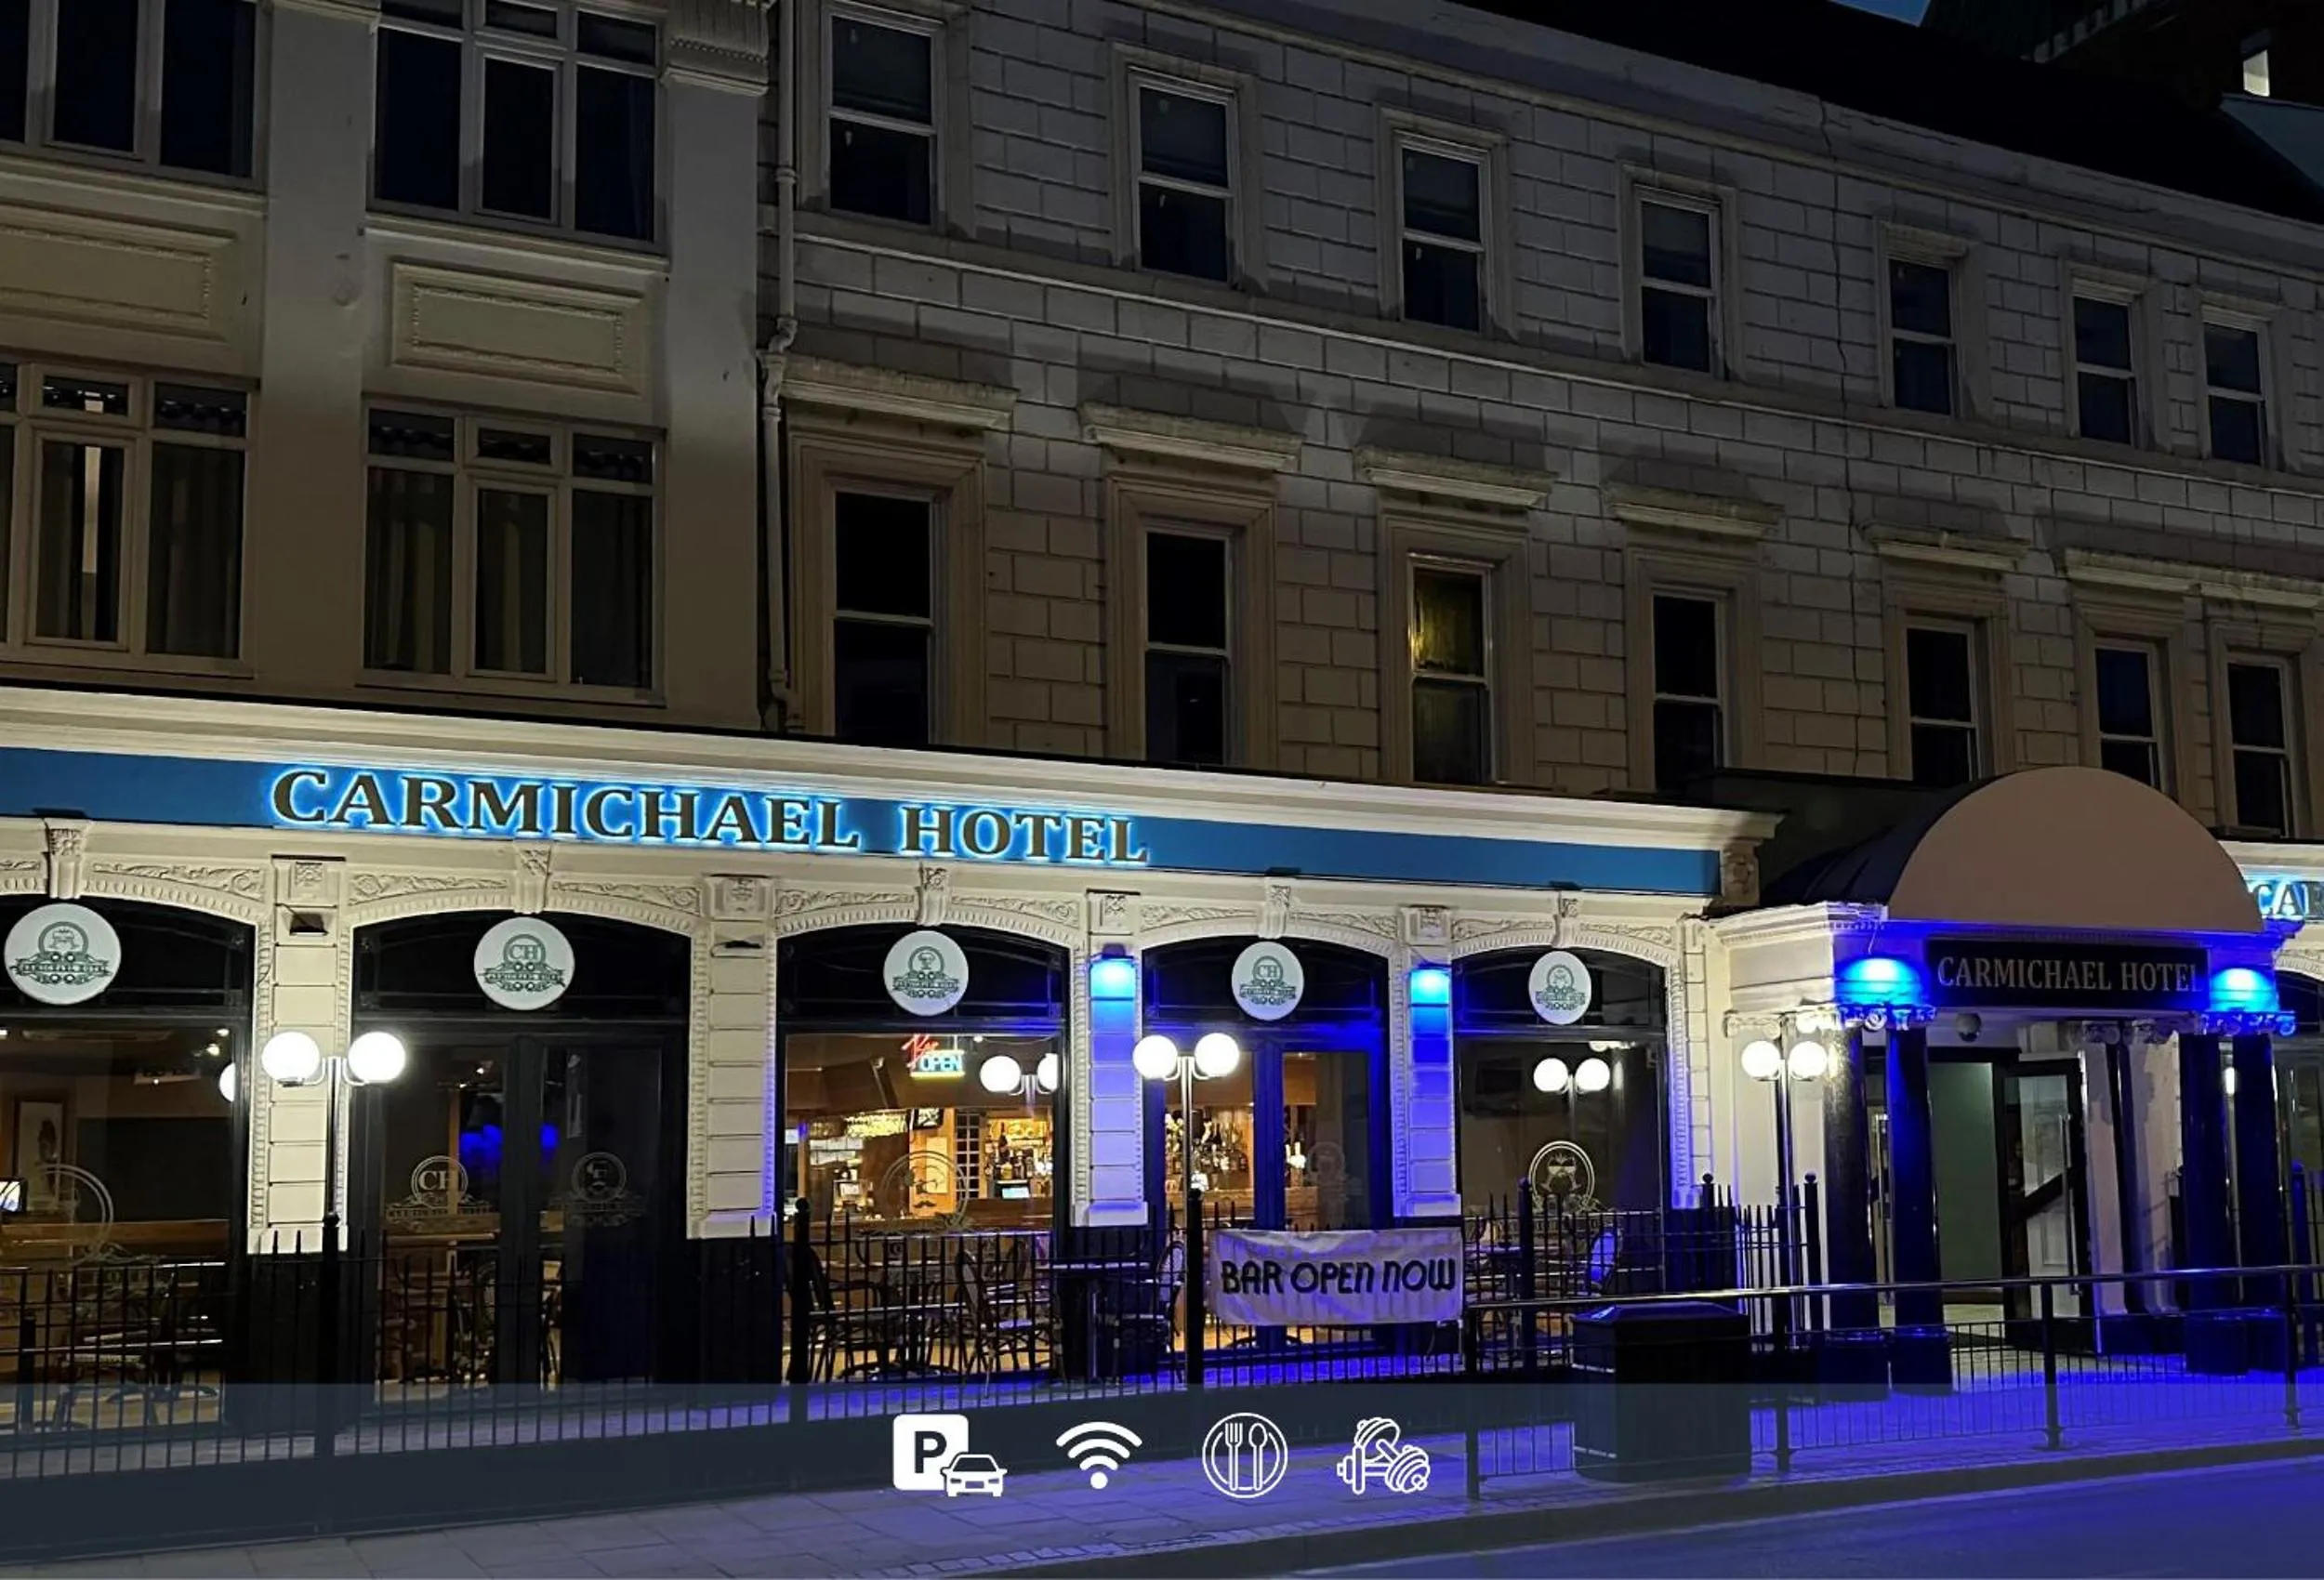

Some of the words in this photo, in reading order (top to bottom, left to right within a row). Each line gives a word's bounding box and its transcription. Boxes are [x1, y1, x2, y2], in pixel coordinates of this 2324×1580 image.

[272, 770, 860, 847] CARMICHAEL
[902, 806, 1148, 862] HOTEL
[1937, 956, 2112, 990] CARMICHAEL
[2119, 962, 2203, 993] HOTEL
[1221, 1260, 1284, 1295] BAR
[1289, 1261, 1375, 1294] OPEN
[1381, 1258, 1456, 1293] NOW
